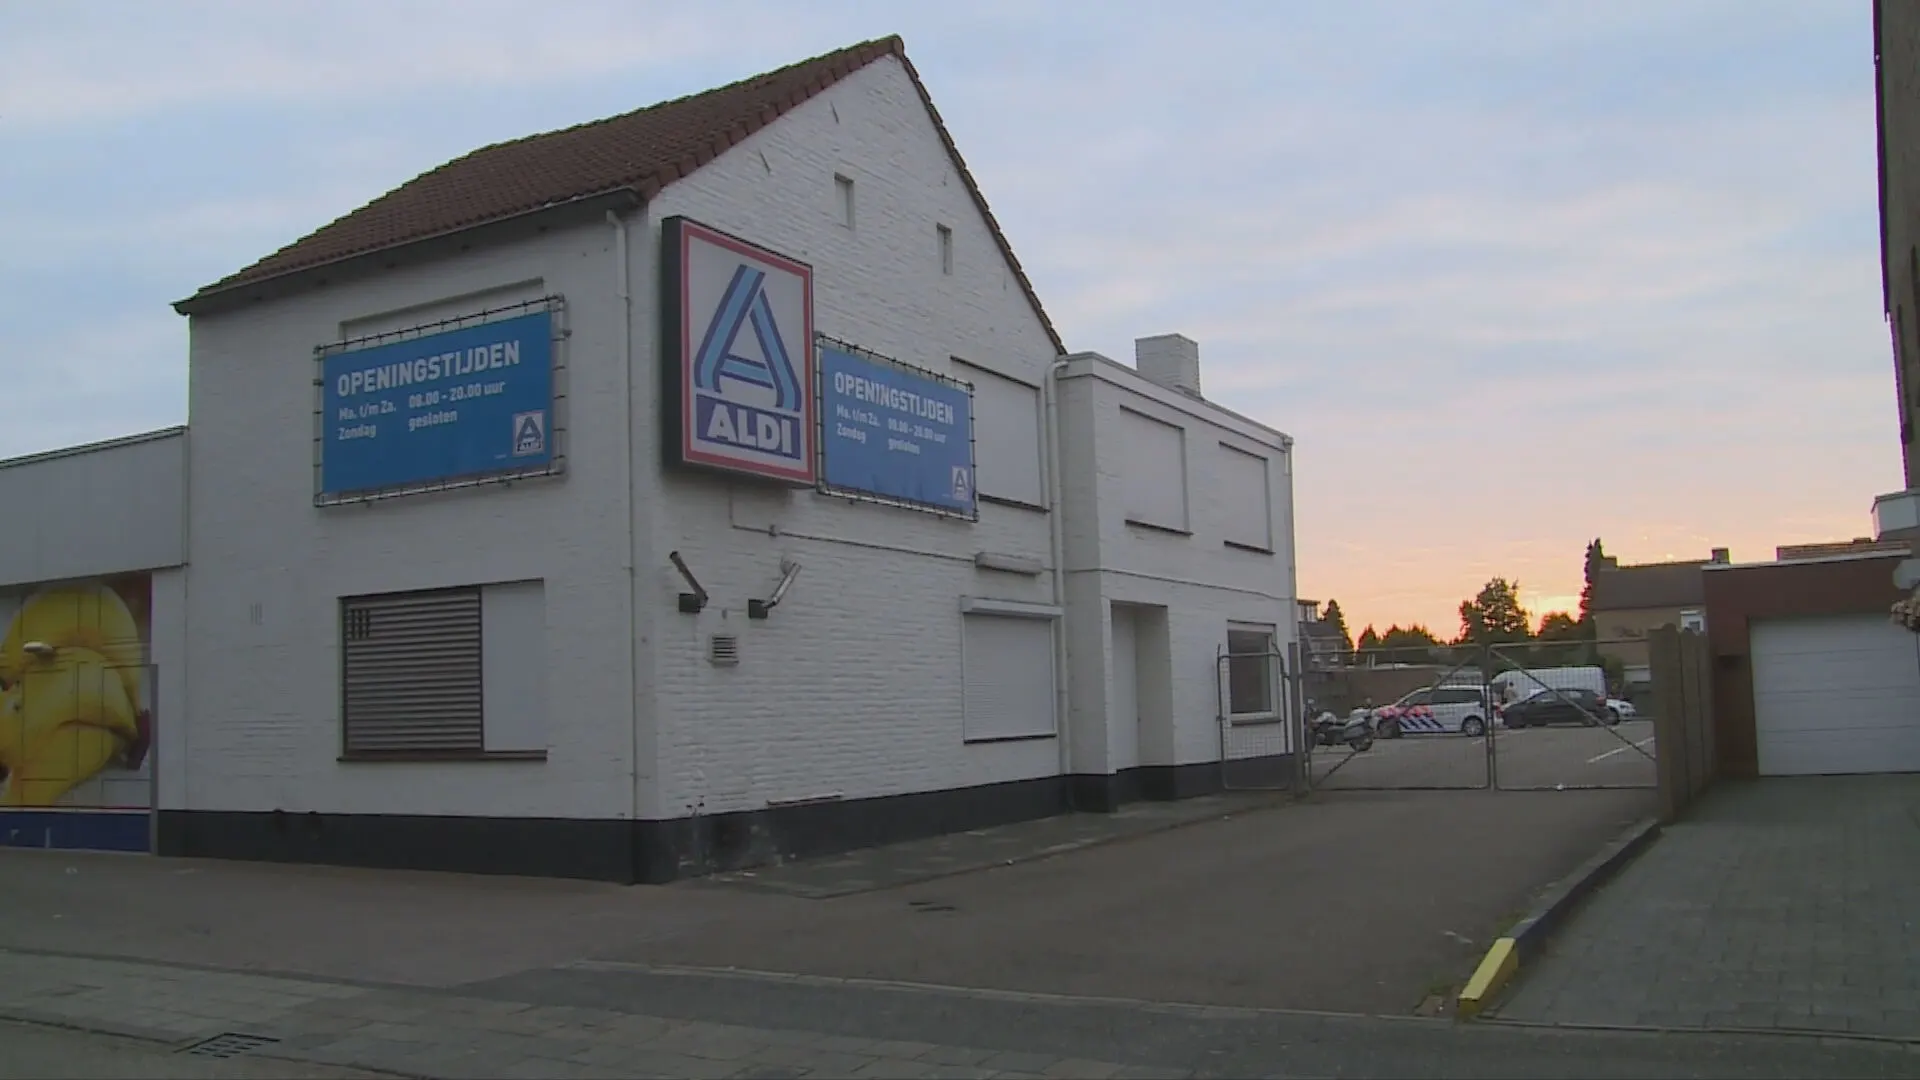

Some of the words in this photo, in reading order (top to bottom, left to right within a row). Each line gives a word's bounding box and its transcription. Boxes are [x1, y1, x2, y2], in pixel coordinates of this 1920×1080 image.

[338, 340, 520, 397] OPENINGSTIJDEN
[450, 383, 481, 401] 20.00
[484, 381, 506, 394] uur
[835, 371, 954, 424] OPENINGSTIJDEN
[338, 424, 377, 440] Zondag
[408, 410, 458, 432] gesloten
[707, 403, 793, 454] ALDI
